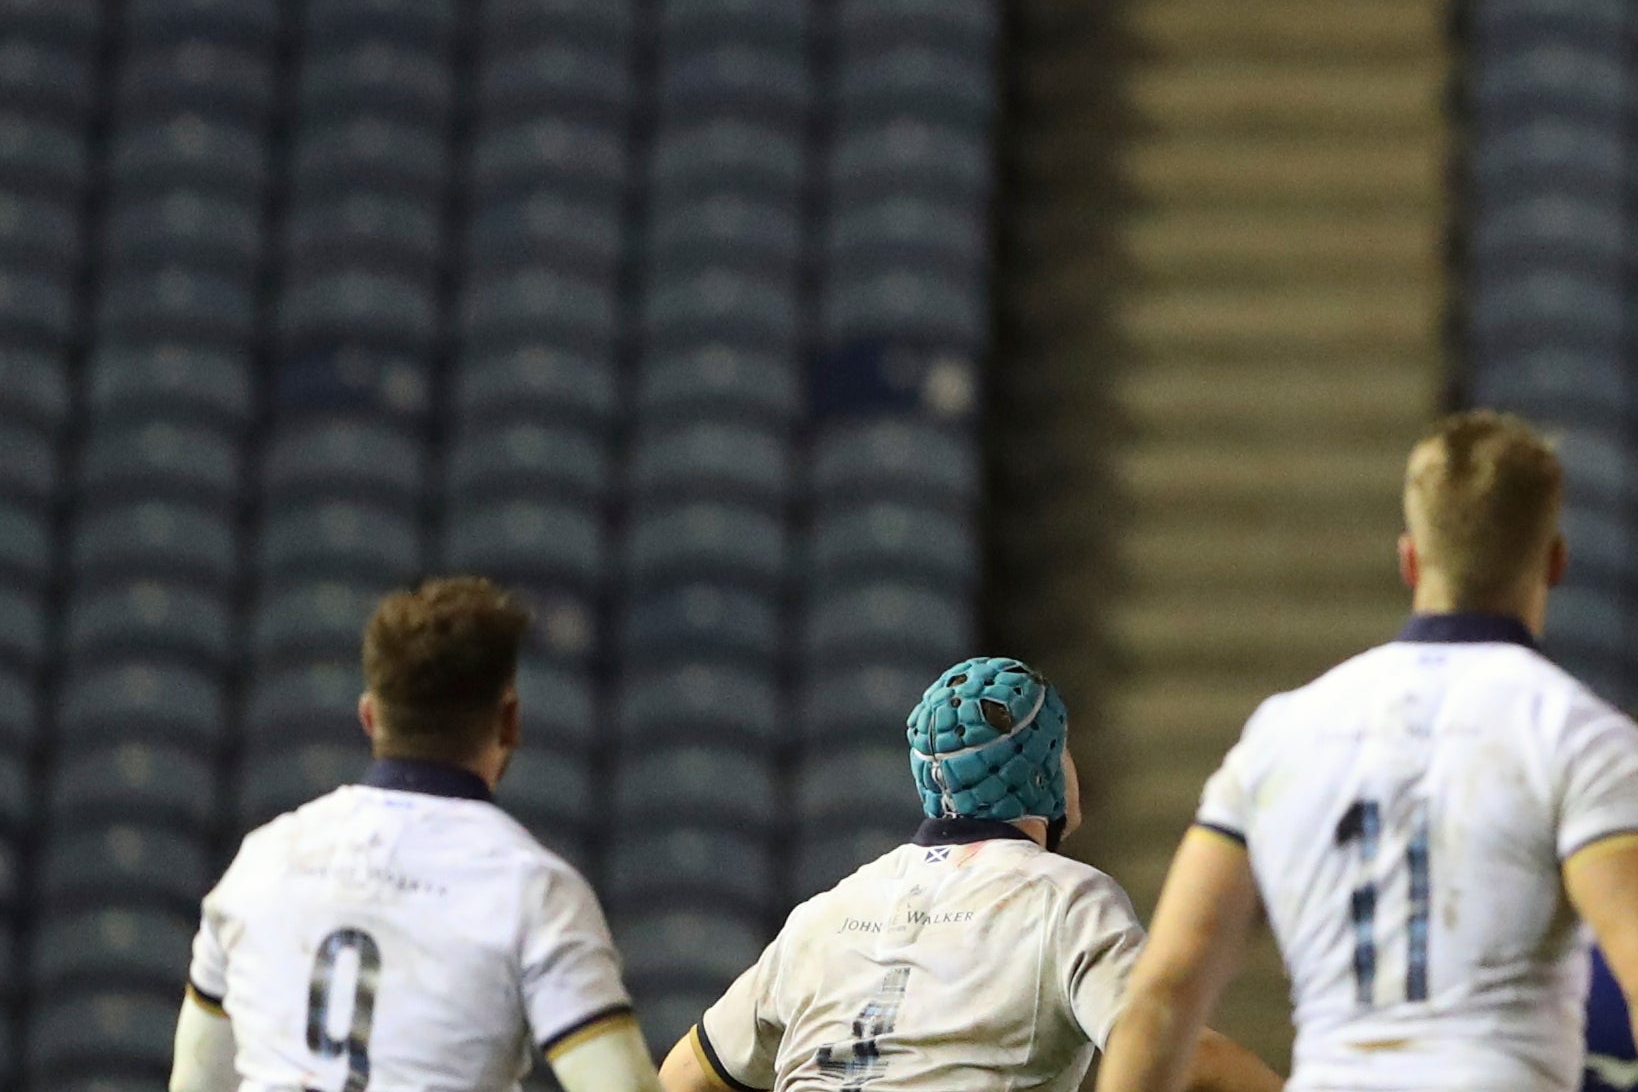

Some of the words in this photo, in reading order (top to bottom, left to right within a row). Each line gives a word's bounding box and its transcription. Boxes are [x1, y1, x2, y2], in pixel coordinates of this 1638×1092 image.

[907, 911, 974, 925] WALKER
[1335, 798, 1429, 1004] 11
[305, 927, 382, 1092] 9
